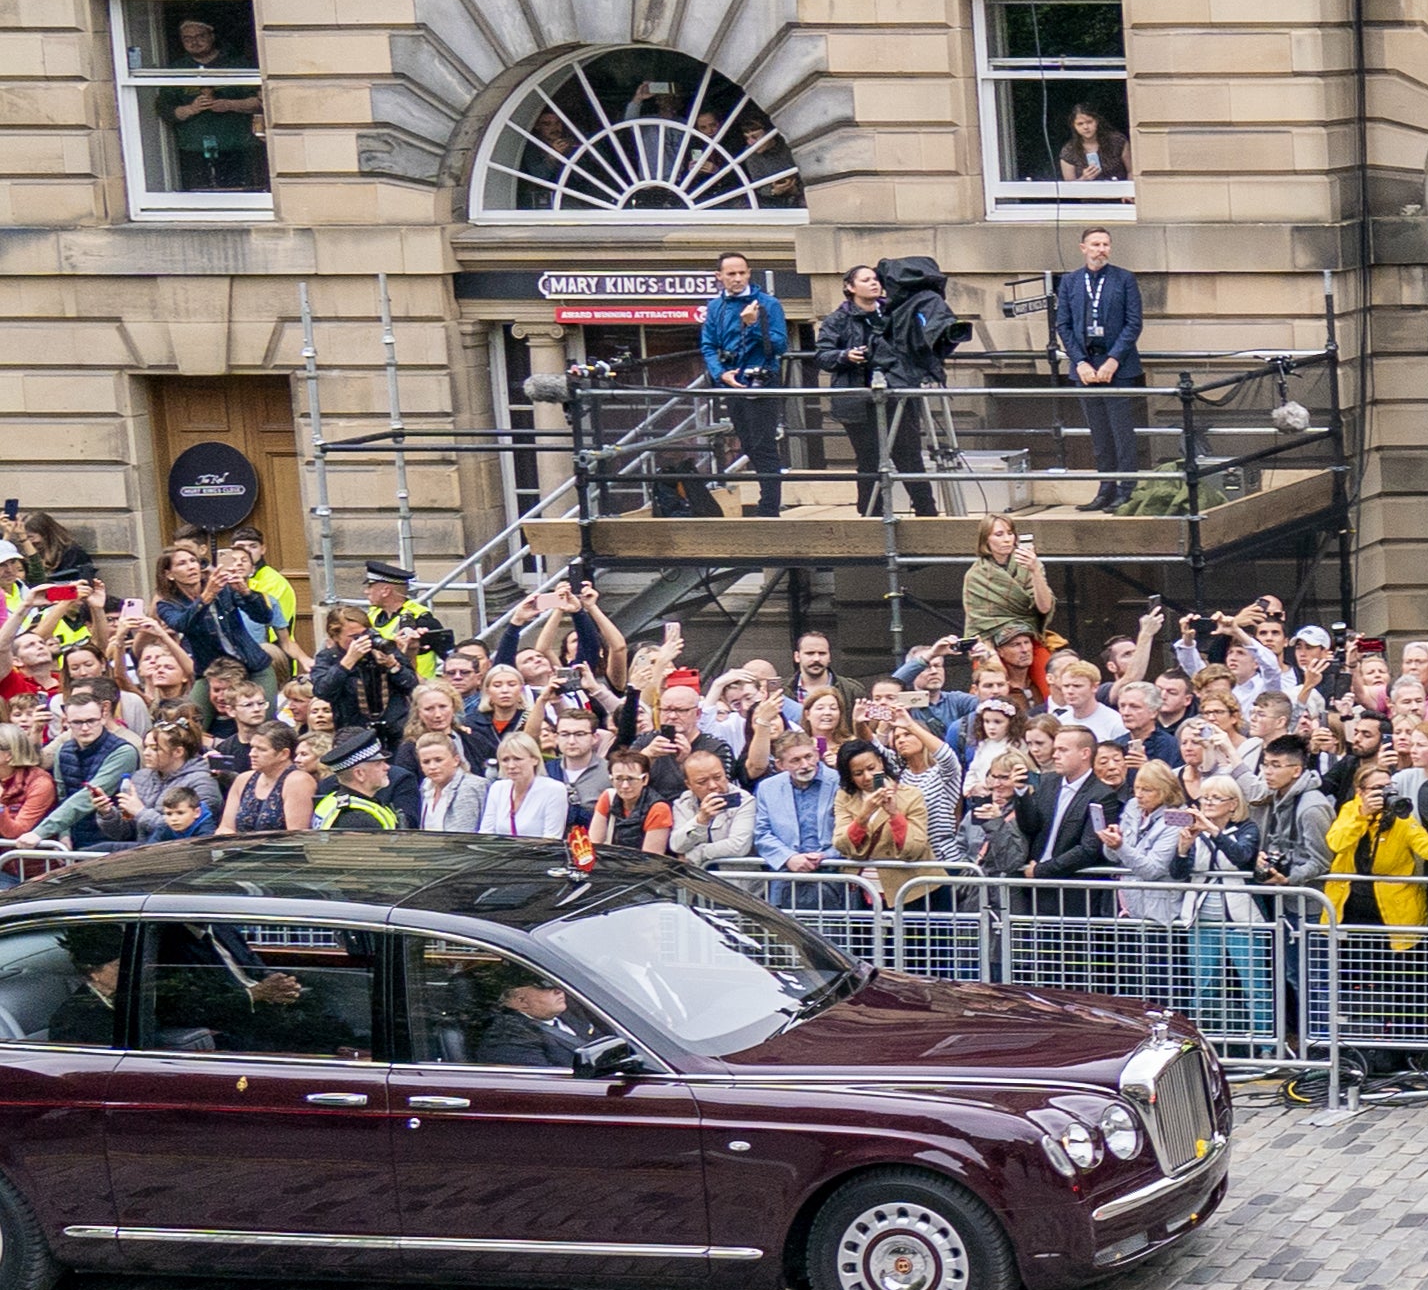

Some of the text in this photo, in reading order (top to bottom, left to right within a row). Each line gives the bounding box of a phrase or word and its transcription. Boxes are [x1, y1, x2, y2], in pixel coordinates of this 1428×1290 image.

[550, 276, 718, 295] MARY KING'S CLOSE
[561, 311, 689, 319] AWARD WINNING ATTRACTION
